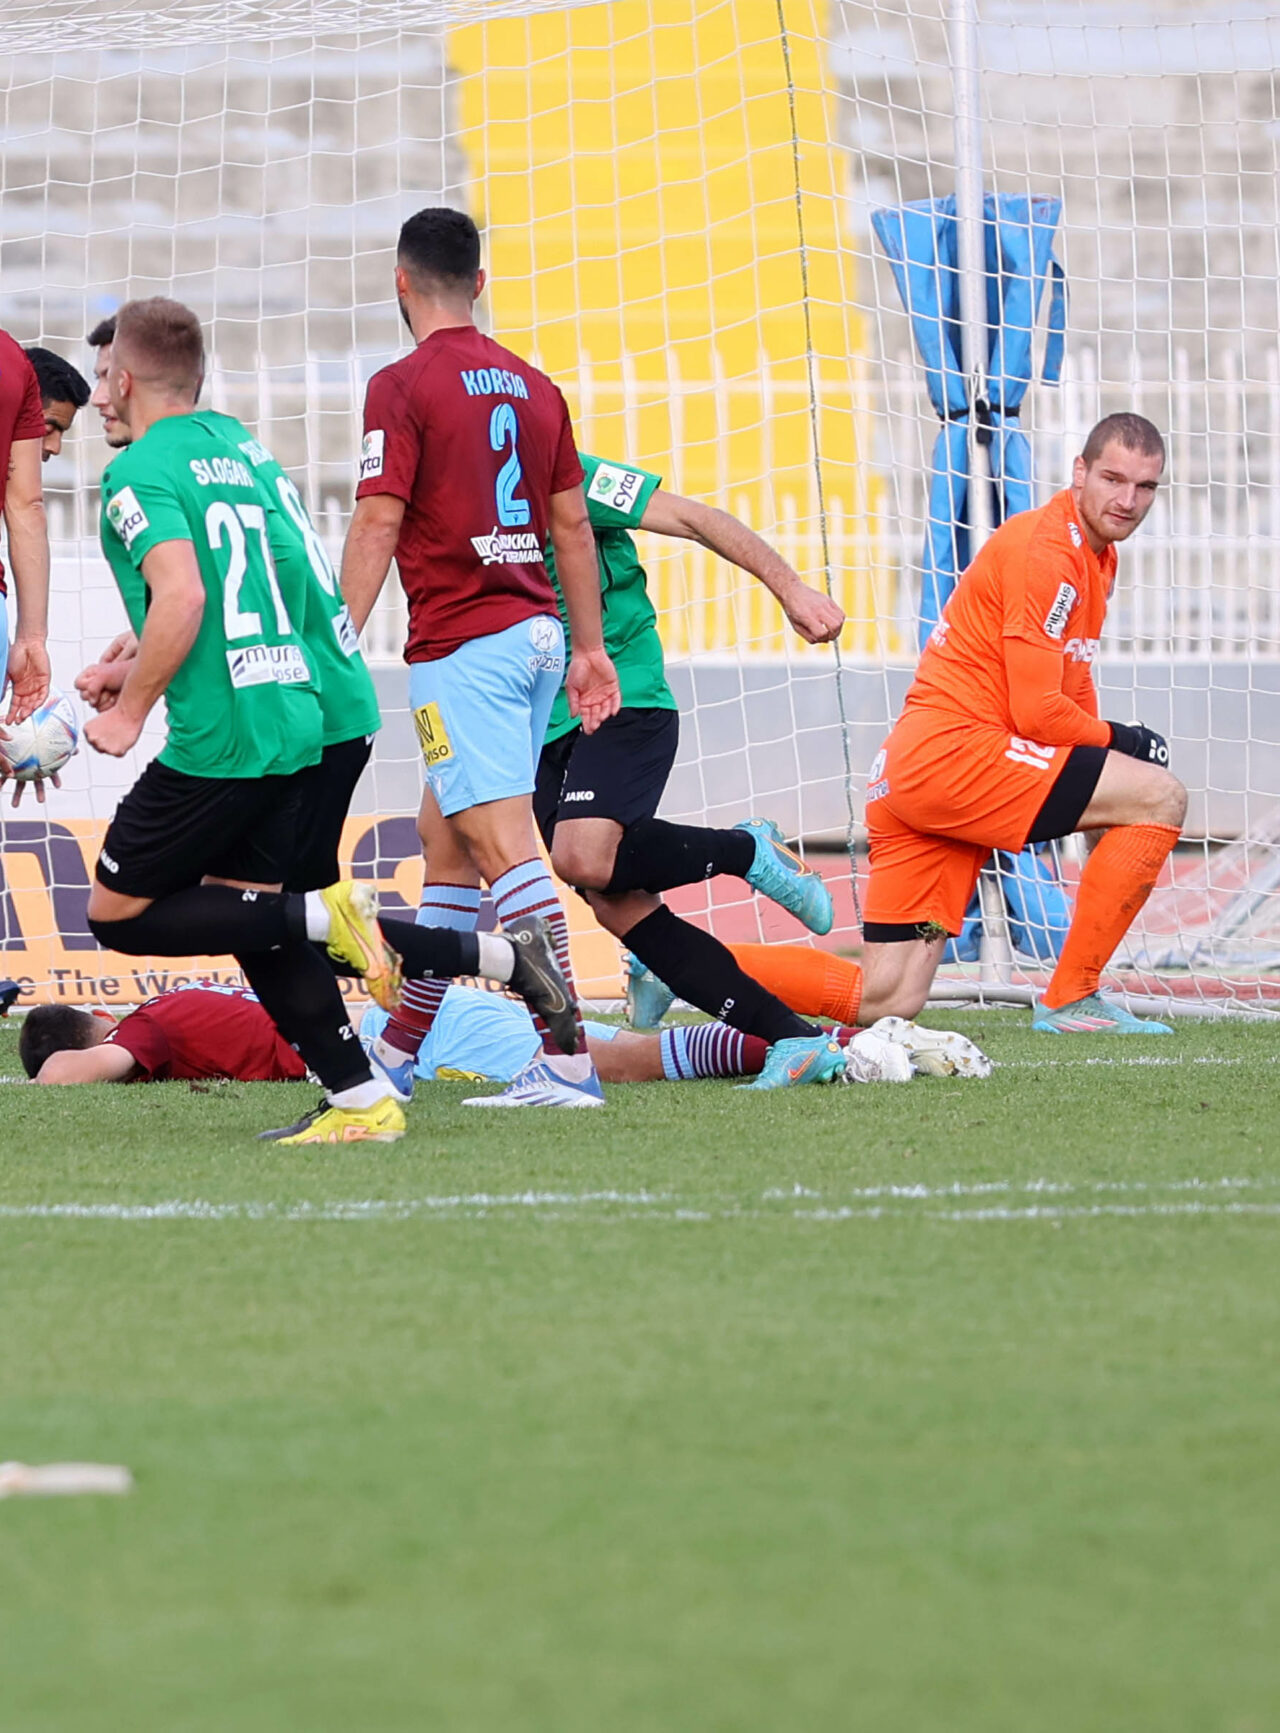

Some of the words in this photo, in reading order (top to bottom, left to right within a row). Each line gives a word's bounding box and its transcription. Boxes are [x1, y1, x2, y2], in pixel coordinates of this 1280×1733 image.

[460, 367, 529, 399] KORSIA
[189, 457, 254, 488] SLOGAR
[360, 456, 380, 479] yta
[488, 402, 531, 527] 2
[613, 473, 637, 508] cyta
[120, 511, 143, 542] yta
[205, 501, 292, 640] 27
[564, 790, 595, 803] JAKO
[48, 969, 121, 997] The
